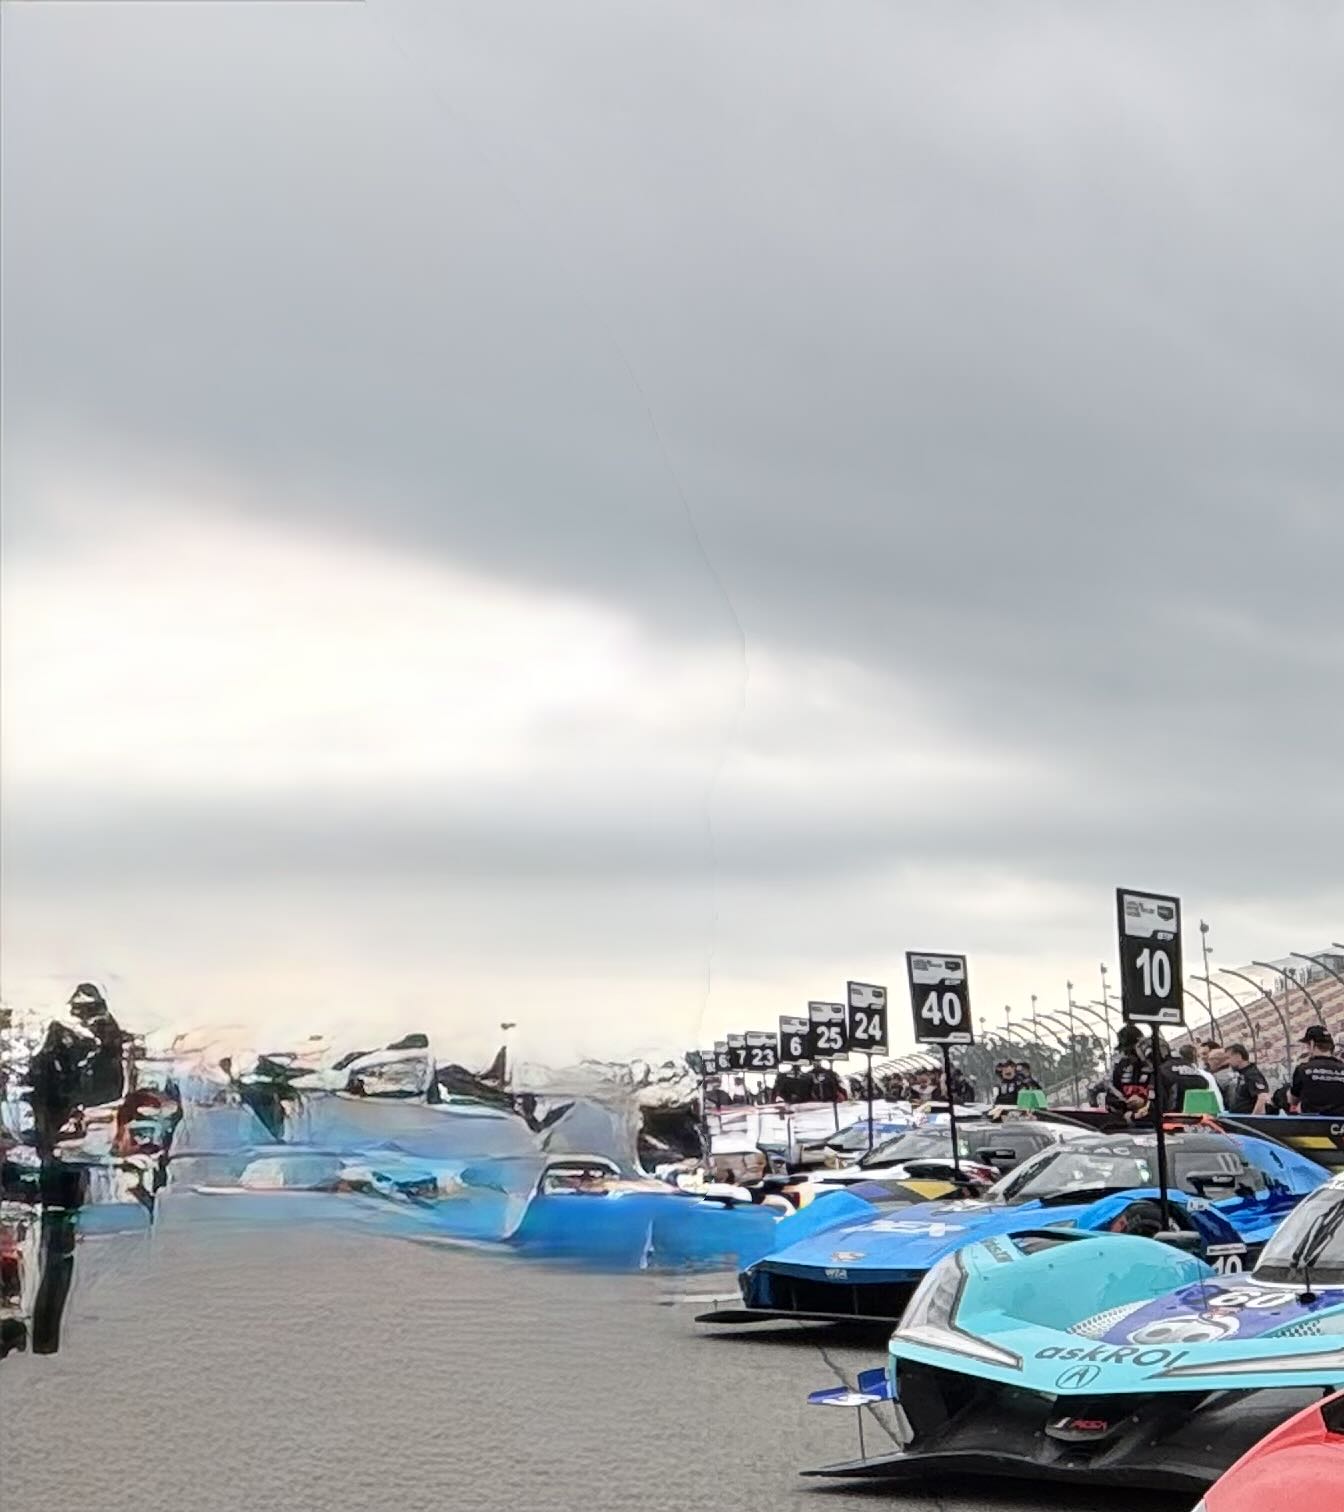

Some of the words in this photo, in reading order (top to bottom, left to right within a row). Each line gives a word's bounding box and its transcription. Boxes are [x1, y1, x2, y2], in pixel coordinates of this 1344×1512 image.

[1136, 948, 1171, 998] 10
[921, 991, 962, 1026] 40
[816, 1026, 843, 1050] 25
[854, 1013, 882, 1041] 24
[751, 1049, 775, 1067] 23
[1208, 1290, 1296, 1308] 60
[1034, 1346, 1191, 1368] askROI
